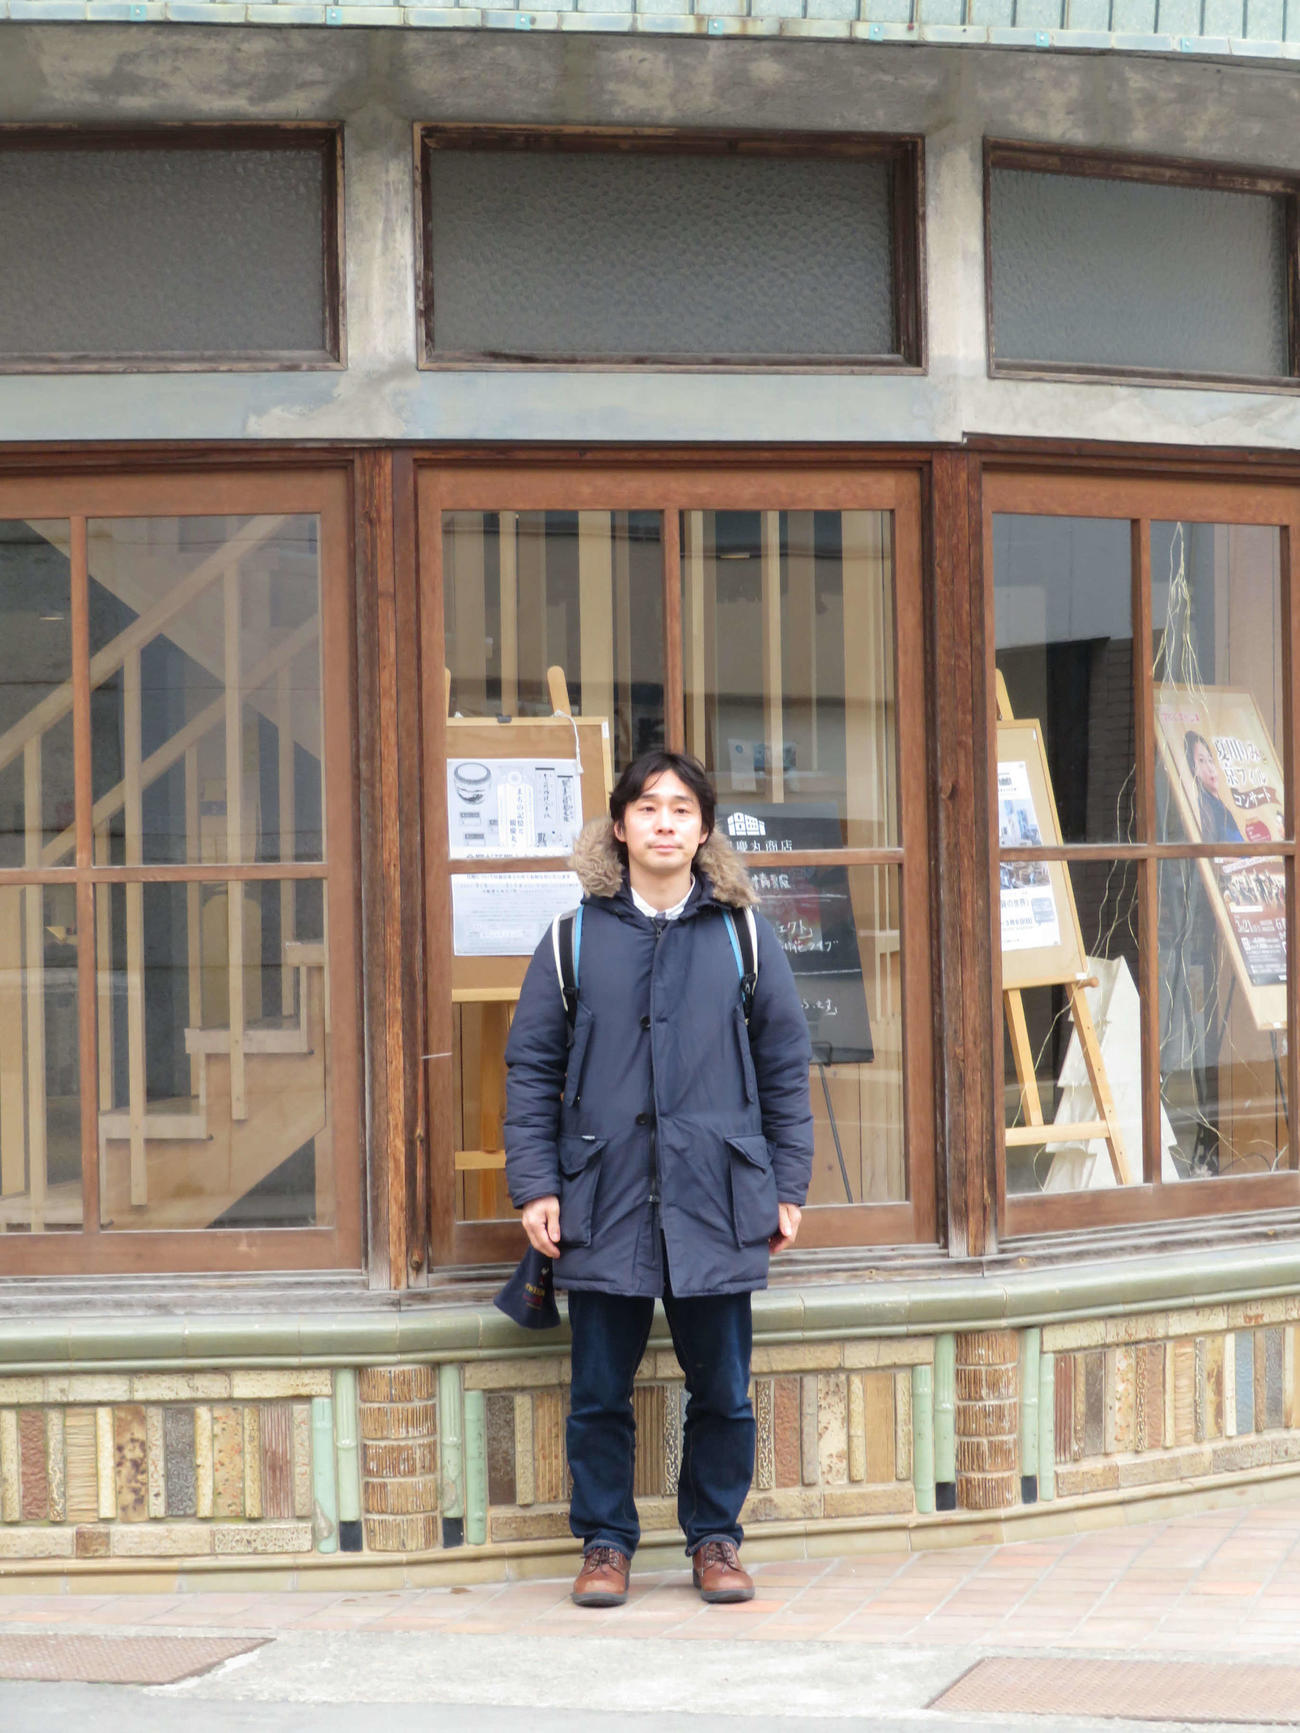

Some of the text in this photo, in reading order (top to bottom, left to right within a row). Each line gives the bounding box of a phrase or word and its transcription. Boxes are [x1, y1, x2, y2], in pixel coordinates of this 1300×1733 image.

[1233, 787, 1272, 809] コンサート
